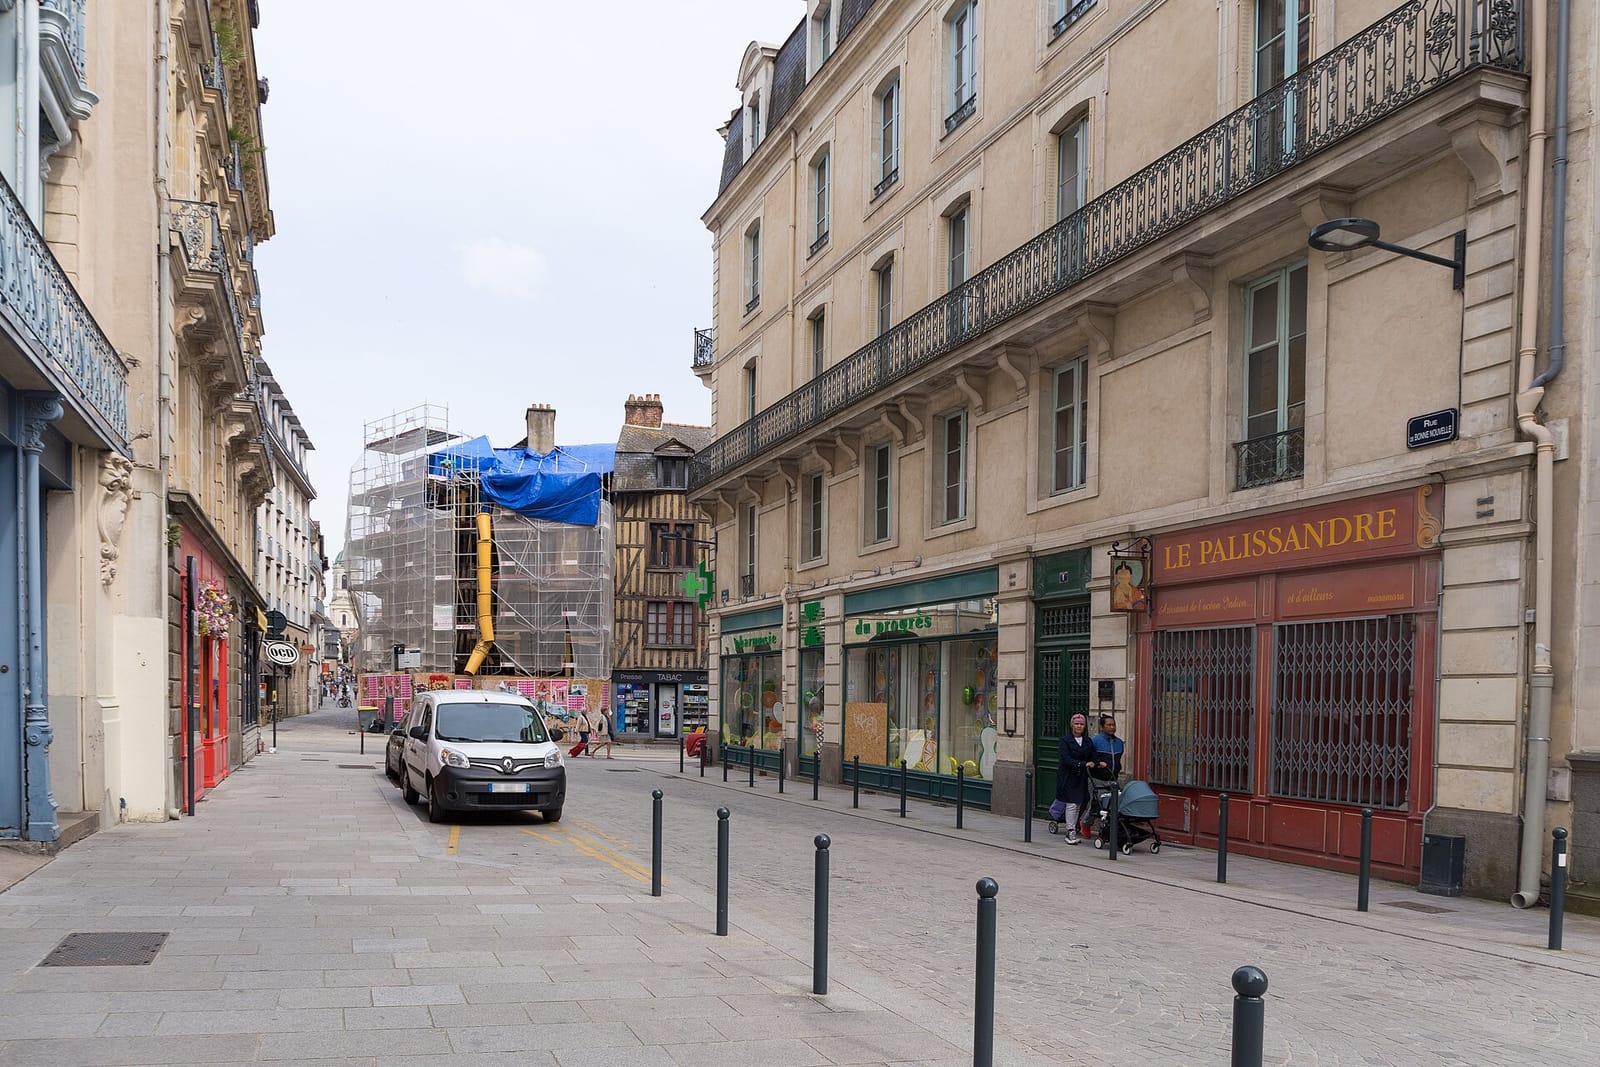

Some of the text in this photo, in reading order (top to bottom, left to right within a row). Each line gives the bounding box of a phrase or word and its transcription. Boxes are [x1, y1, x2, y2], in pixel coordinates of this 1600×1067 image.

[1430, 424, 1452, 437] NOUVELLE
[1163, 508, 1397, 570] LE PALISSANDRE
[855, 607, 932, 637] du progrès
[270, 647, 294, 658] OCD
[657, 673, 682, 681] TABAC
